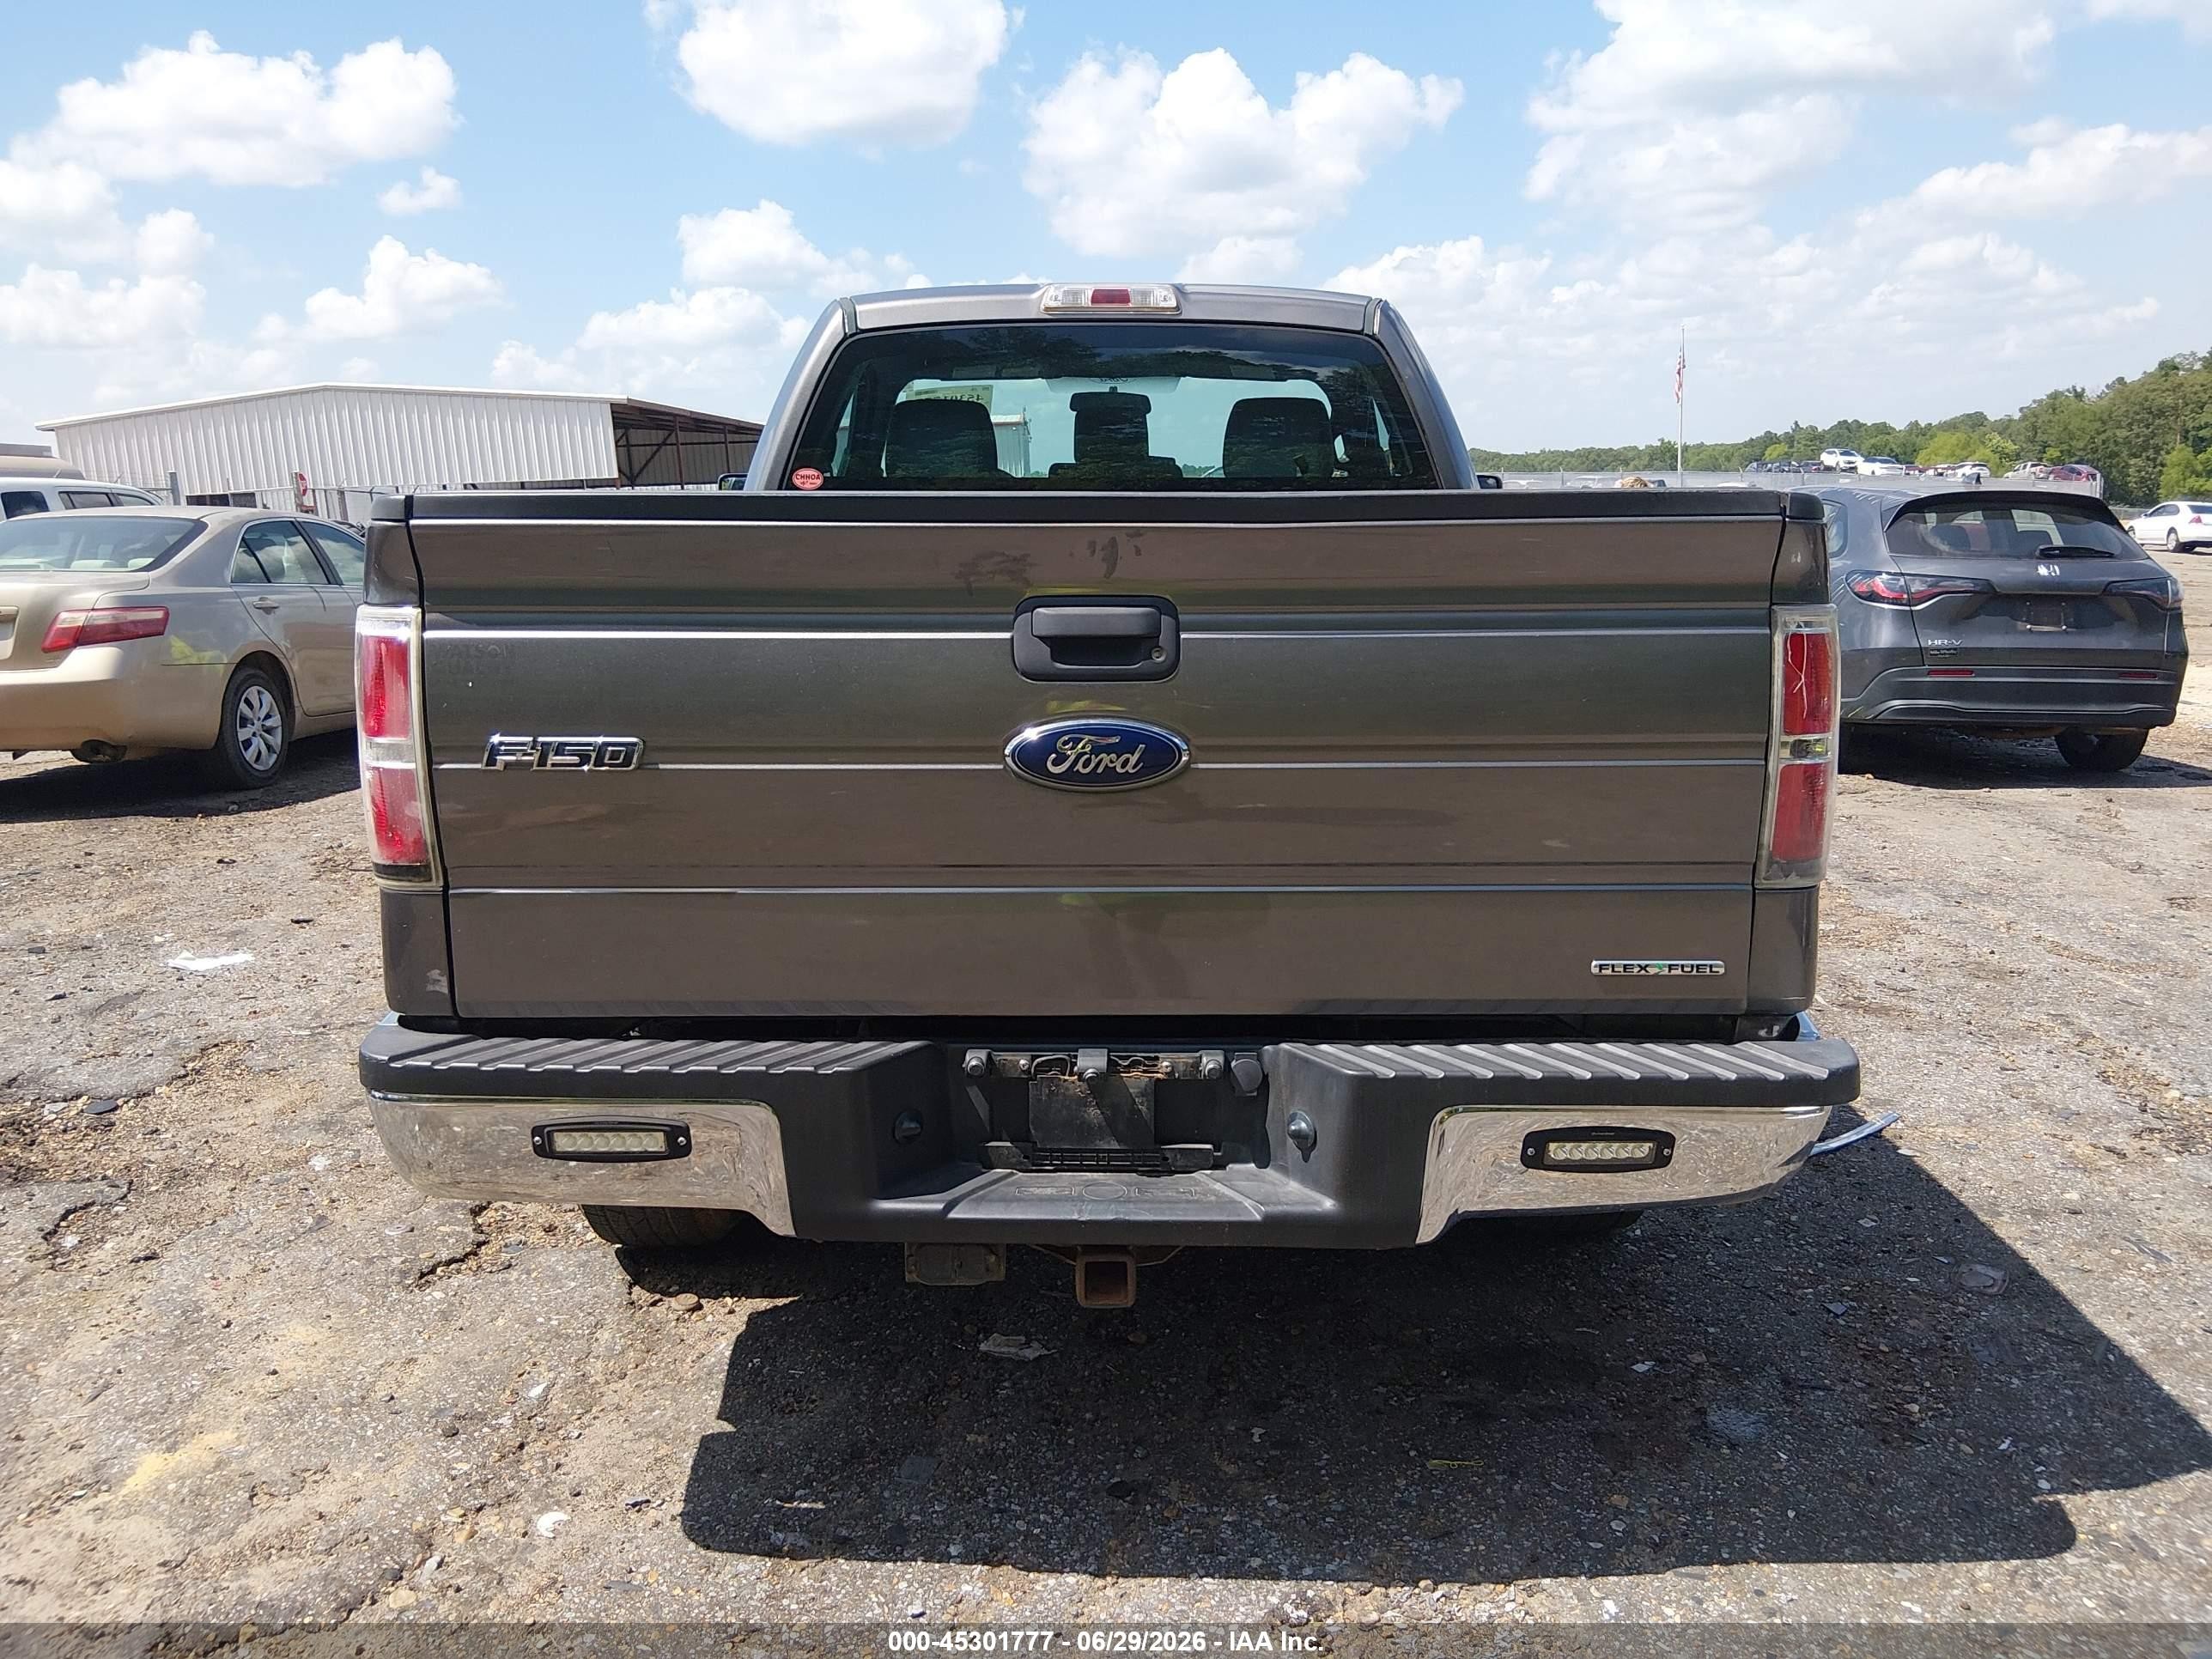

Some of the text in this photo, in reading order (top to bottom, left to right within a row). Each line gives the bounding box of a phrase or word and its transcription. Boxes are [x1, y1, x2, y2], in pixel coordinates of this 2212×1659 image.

[1046, 733, 1146, 774] Ford
[1598, 963, 1721, 974] FLEX FUEL
